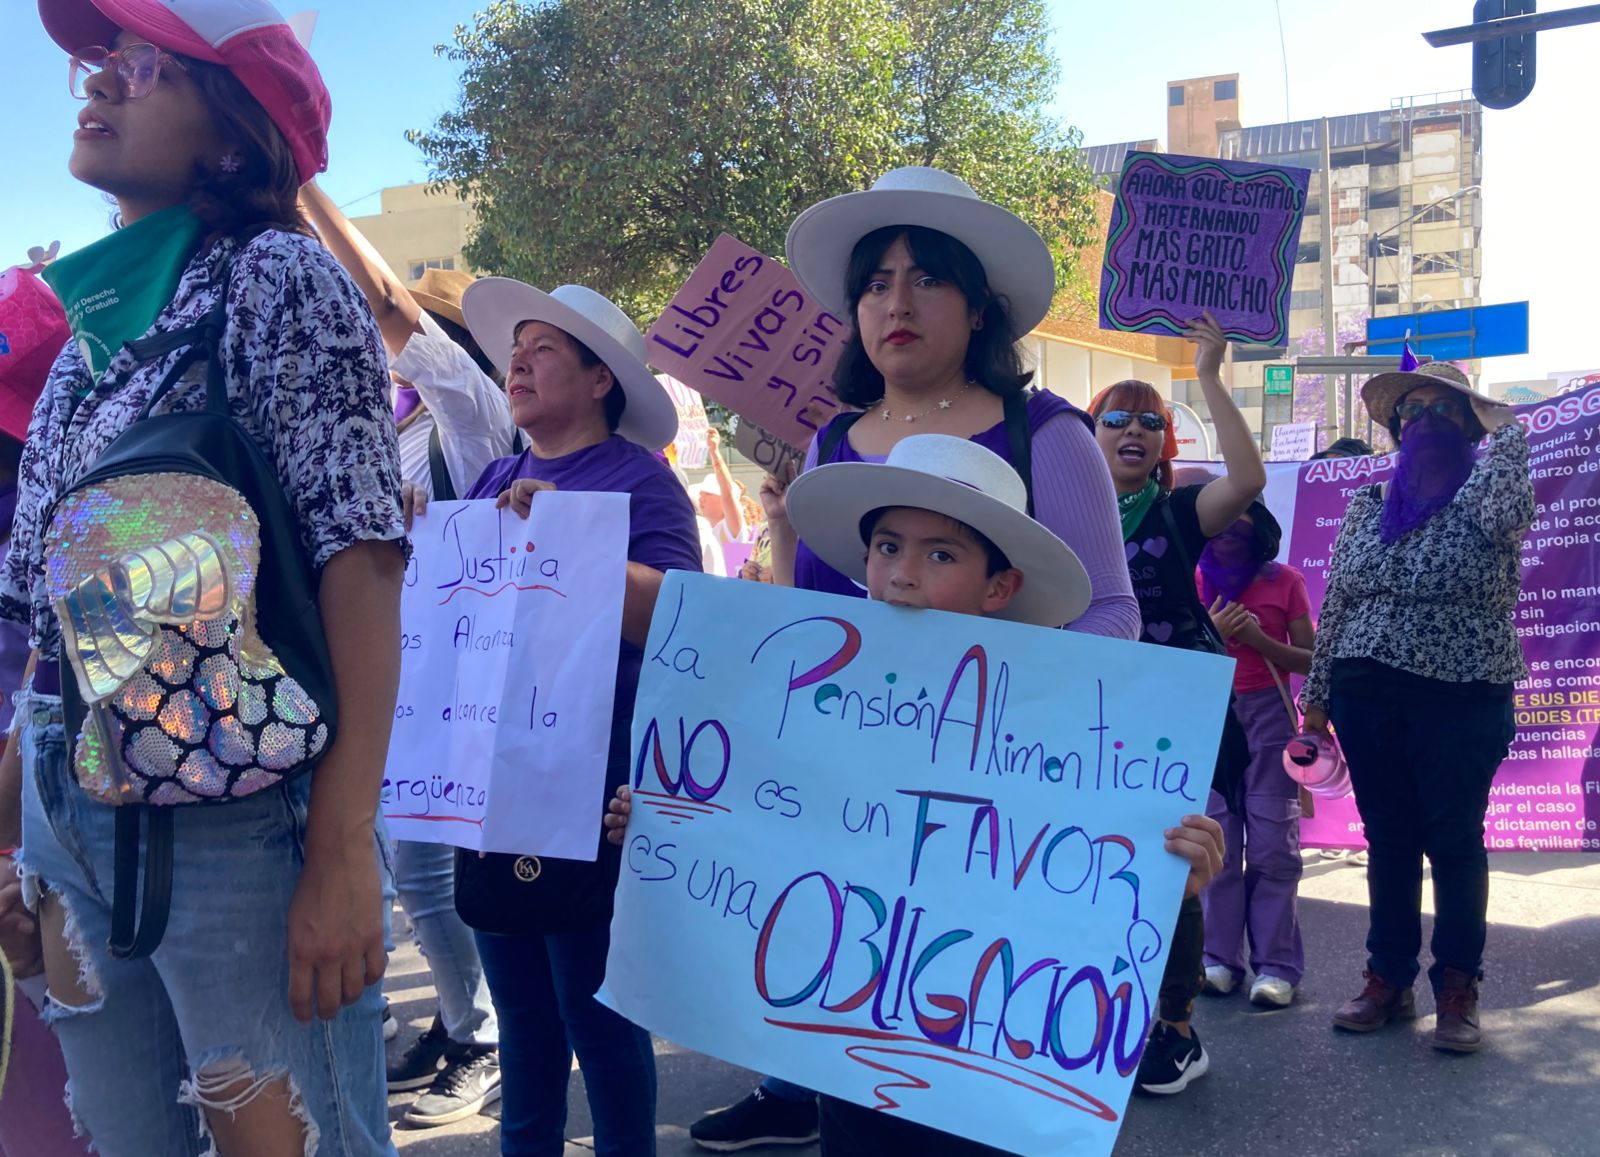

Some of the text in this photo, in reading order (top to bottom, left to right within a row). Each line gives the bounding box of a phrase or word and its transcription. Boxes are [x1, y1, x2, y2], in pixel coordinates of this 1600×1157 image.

[1126, 172, 1305, 213] AHORA QUE ESTAMOS
[1143, 204, 1261, 236] MATERNANDO
[1134, 226, 1249, 272] MÁS GRITO,
[1127, 258, 1269, 314] MÁS MARCHO
[80, 287, 116, 307] Derecho
[85, 296, 120, 314] Gratuito
[652, 254, 764, 359] Libres
[702, 288, 805, 383] Vivas
[766, 375, 798, 408] y
[792, 311, 844, 367] sin
[1530, 431, 1576, 454] arquiz
[1583, 427, 1593, 440] y
[1527, 444, 1591, 467] tamento
[1305, 455, 1397, 483] ARAB
[1550, 499, 1565, 512] el
[1569, 497, 1600, 512] pro
[1530, 519, 1551, 532] de
[1554, 516, 1570, 529] lo
[1536, 532, 1590, 551] propia
[1303, 557, 1325, 568] fue
[1520, 555, 1545, 567] es.
[1541, 587, 1557, 600] lo
[1520, 606, 1544, 619] sin
[1530, 660, 1550, 671] se
[651, 582, 1197, 802] La Pensión Alimenticia
[1513, 694, 1526, 707] E
[1529, 692, 1565, 706] SUS
[441, 677, 498, 724] alcance
[529, 685, 558, 730] la
[1510, 728, 1586, 743] ruencias
[1505, 746, 1538, 760] bas
[1565, 782, 1581, 794] la
[1516, 800, 1532, 813] el
[1535, 801, 1576, 813] caso
[634, 716, 1140, 921] NO es un FAVOR
[1494, 818, 1571, 831] dictamen
[1575, 817, 1597, 830] de
[1491, 836, 1515, 849] los
[628, 834, 1162, 1077] es una OBLIGACIÓN
